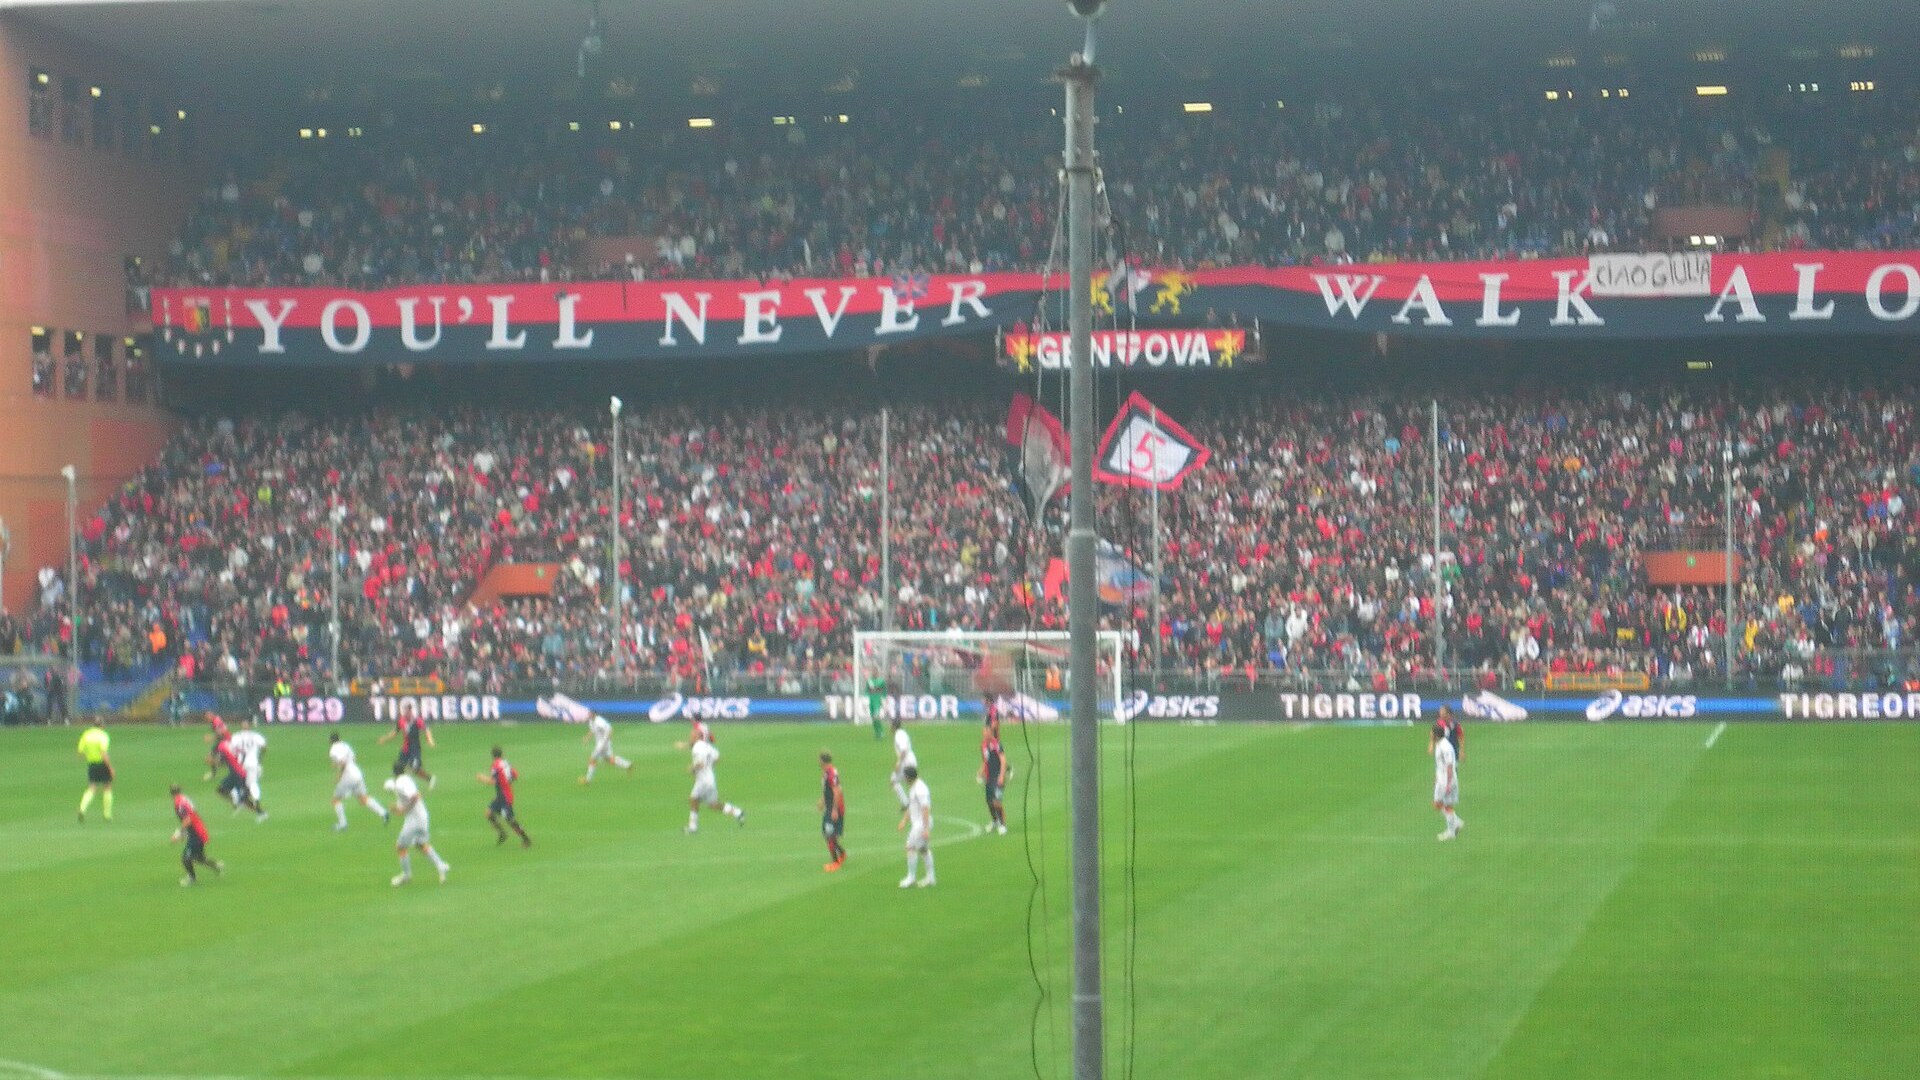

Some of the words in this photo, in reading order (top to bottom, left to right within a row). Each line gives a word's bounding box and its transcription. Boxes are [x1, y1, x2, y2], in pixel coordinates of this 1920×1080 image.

[244, 293, 595, 354] YOU'LL
[659, 280, 993, 347] NEVER
[1309, 269, 1606, 327] WALK
[1703, 263, 1920, 323] ALO
[1127, 431, 1166, 473] 5
[1281, 693, 1422, 719] TIGREOR
